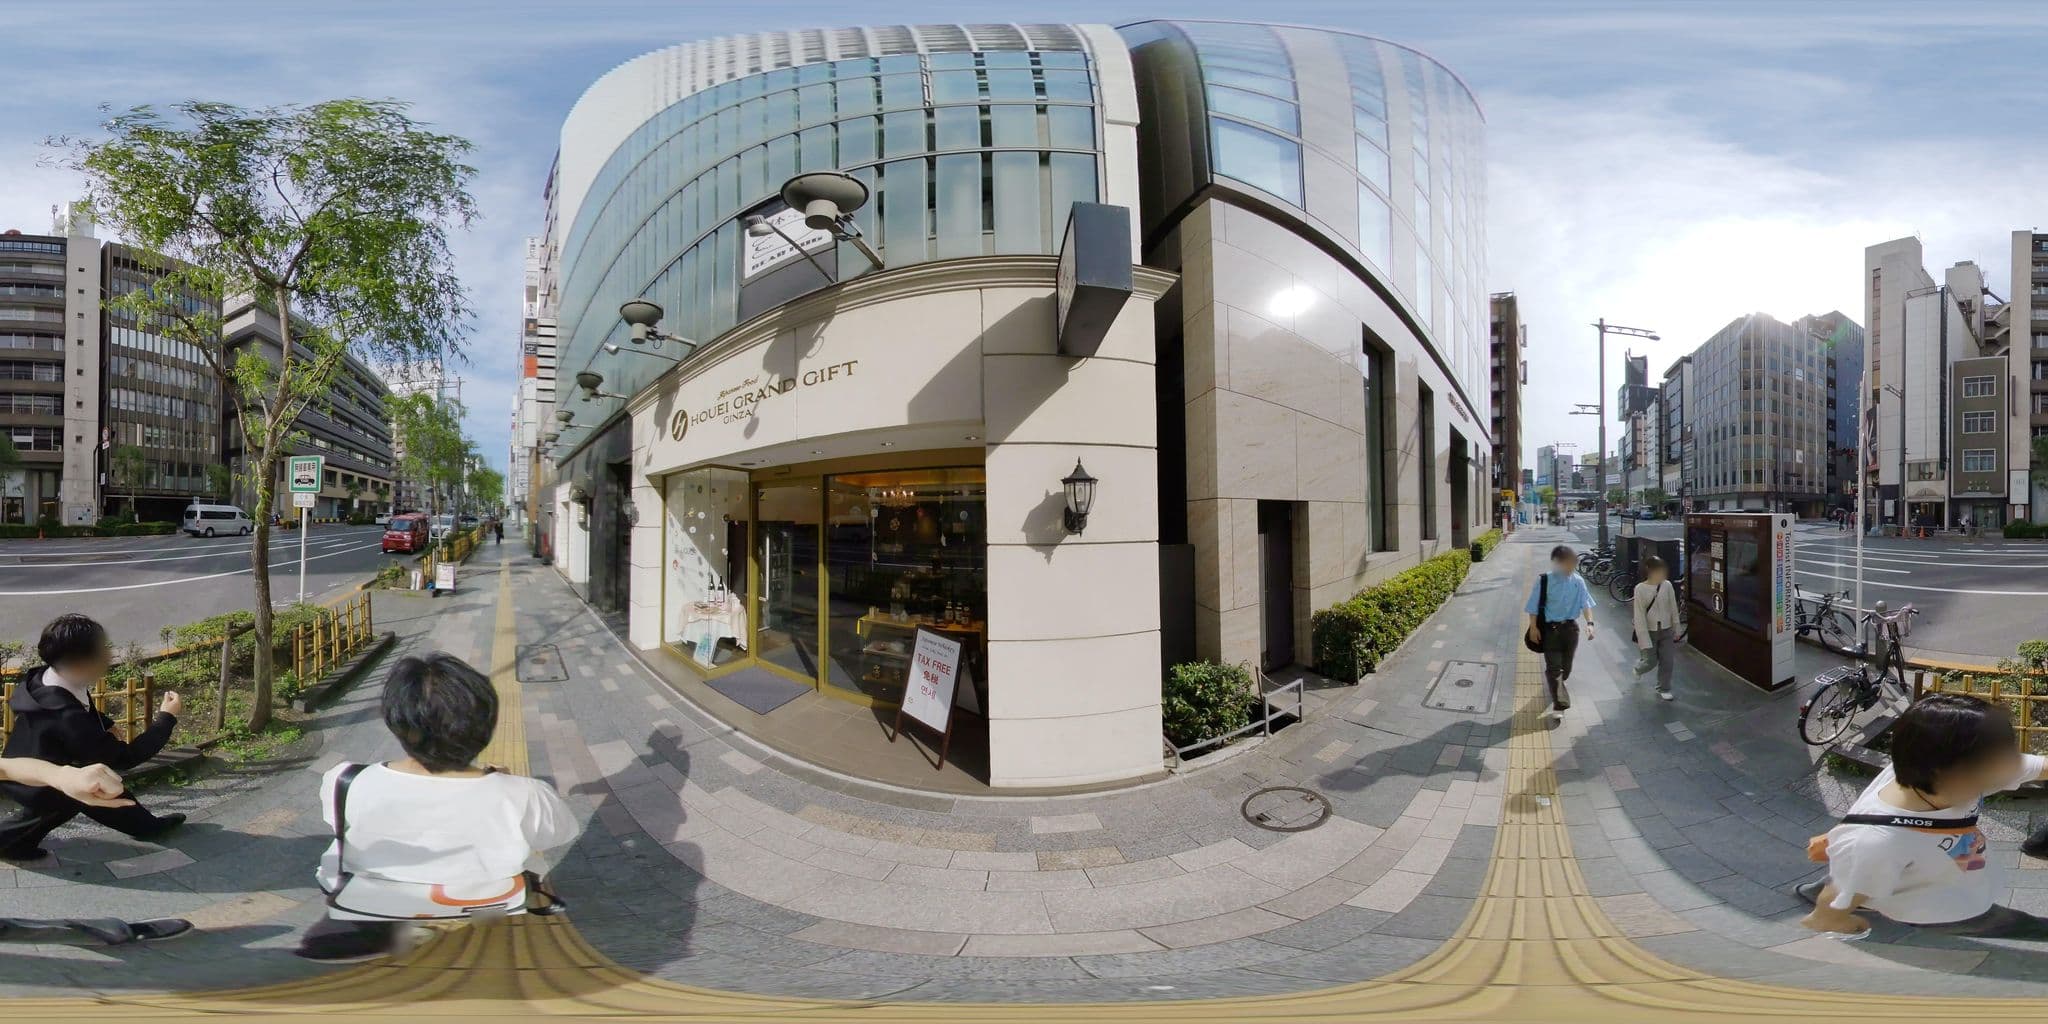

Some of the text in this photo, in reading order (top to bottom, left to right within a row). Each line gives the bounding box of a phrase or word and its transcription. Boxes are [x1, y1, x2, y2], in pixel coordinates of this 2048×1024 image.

[691, 402, 728, 426] HOUEI
[733, 378, 797, 410] GRAND
[803, 360, 859, 386] GIFT
[723, 409, 753, 425] GINZA
[918, 653, 951, 676] TAX FREE
[1891, 817, 1933, 826] SONY
